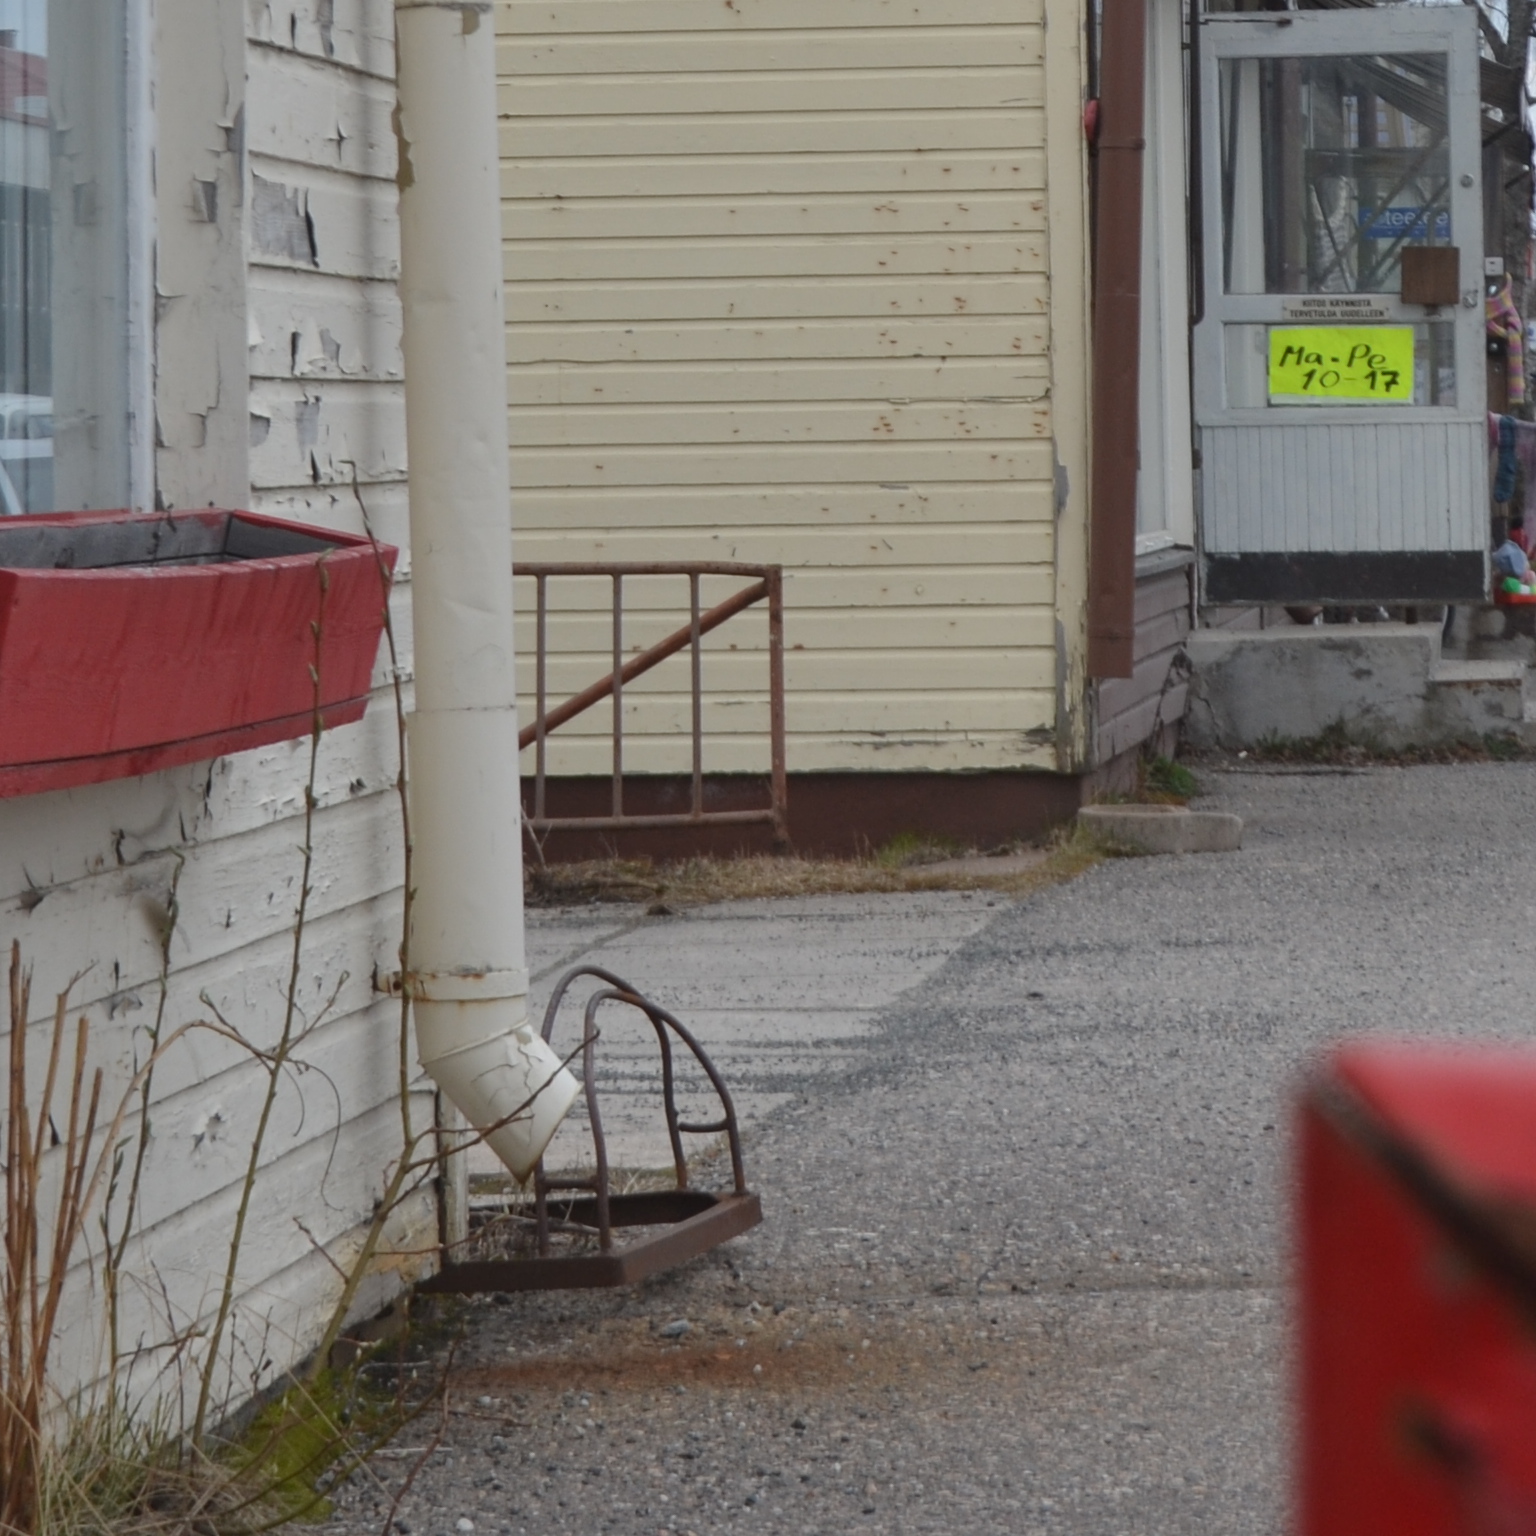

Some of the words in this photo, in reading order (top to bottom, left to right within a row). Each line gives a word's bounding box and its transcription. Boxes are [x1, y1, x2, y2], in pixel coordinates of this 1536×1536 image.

[1302, 299, 1327, 307] KIITOS
[1290, 309, 1337, 318] TERVETULOA
[1340, 309, 1385, 317] UUDELLEEN
